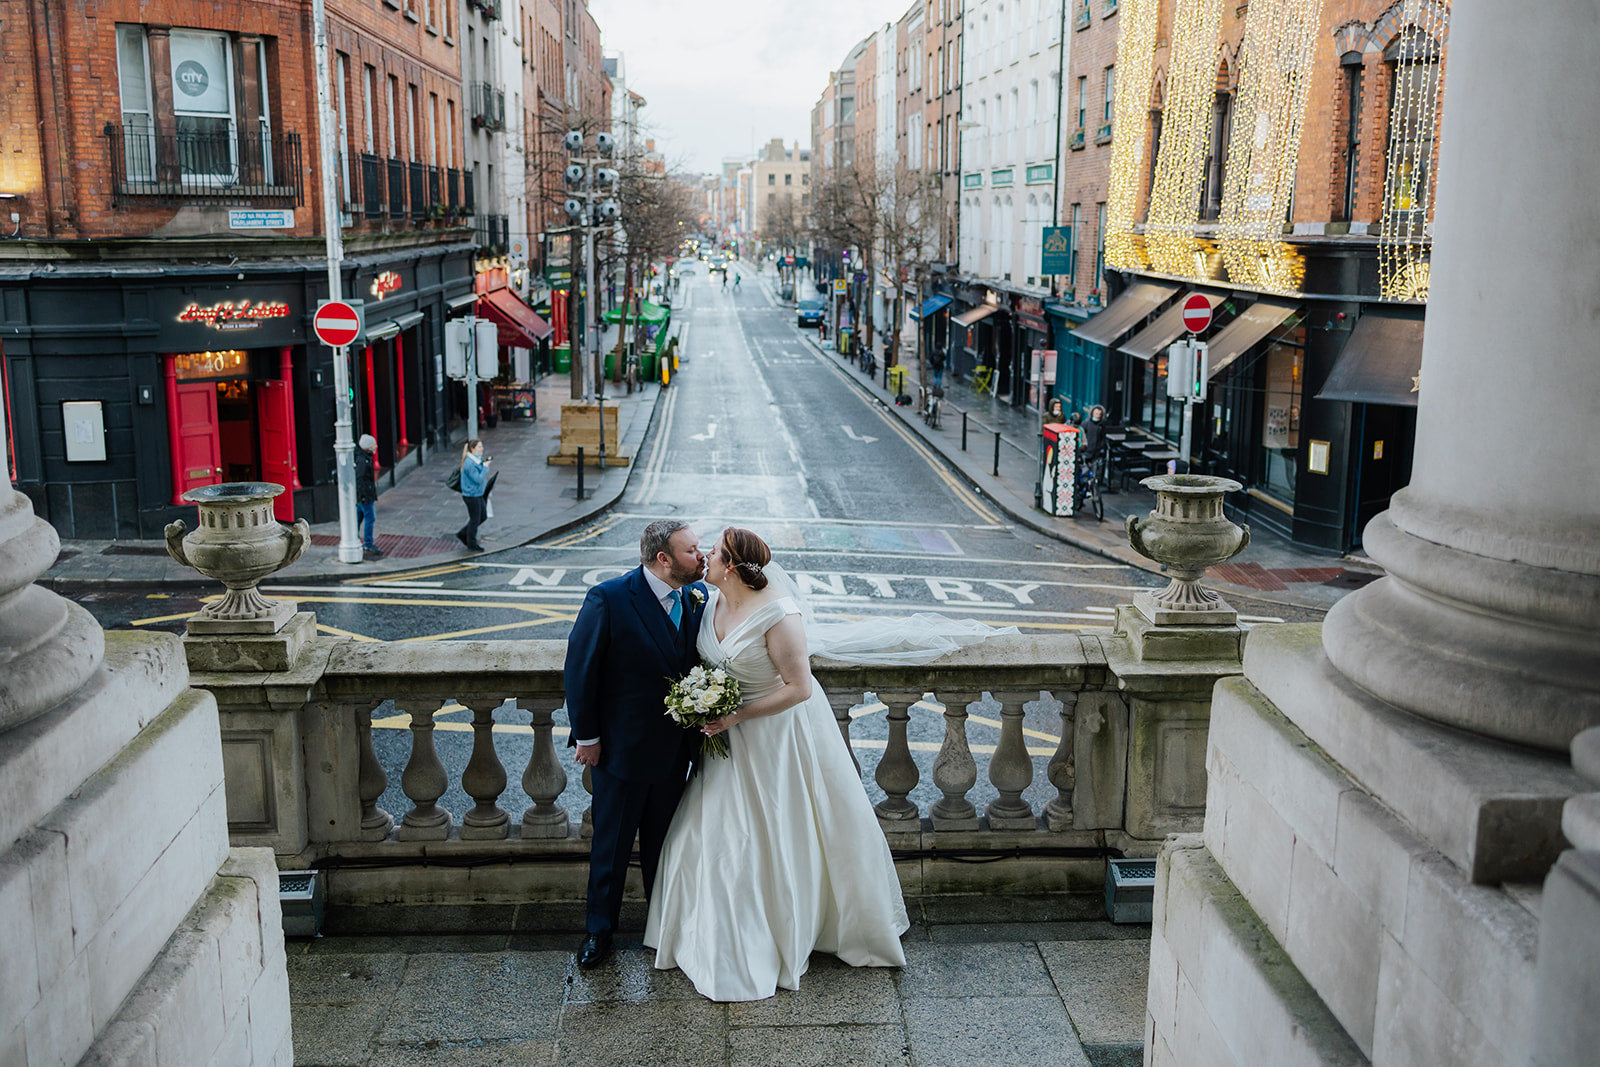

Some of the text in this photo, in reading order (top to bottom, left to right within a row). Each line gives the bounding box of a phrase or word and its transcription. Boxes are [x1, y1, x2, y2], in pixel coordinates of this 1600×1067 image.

[181, 69, 203, 83] CITY
[204, 357, 225, 373] 40
[796, 573, 1041, 604] NTRY
